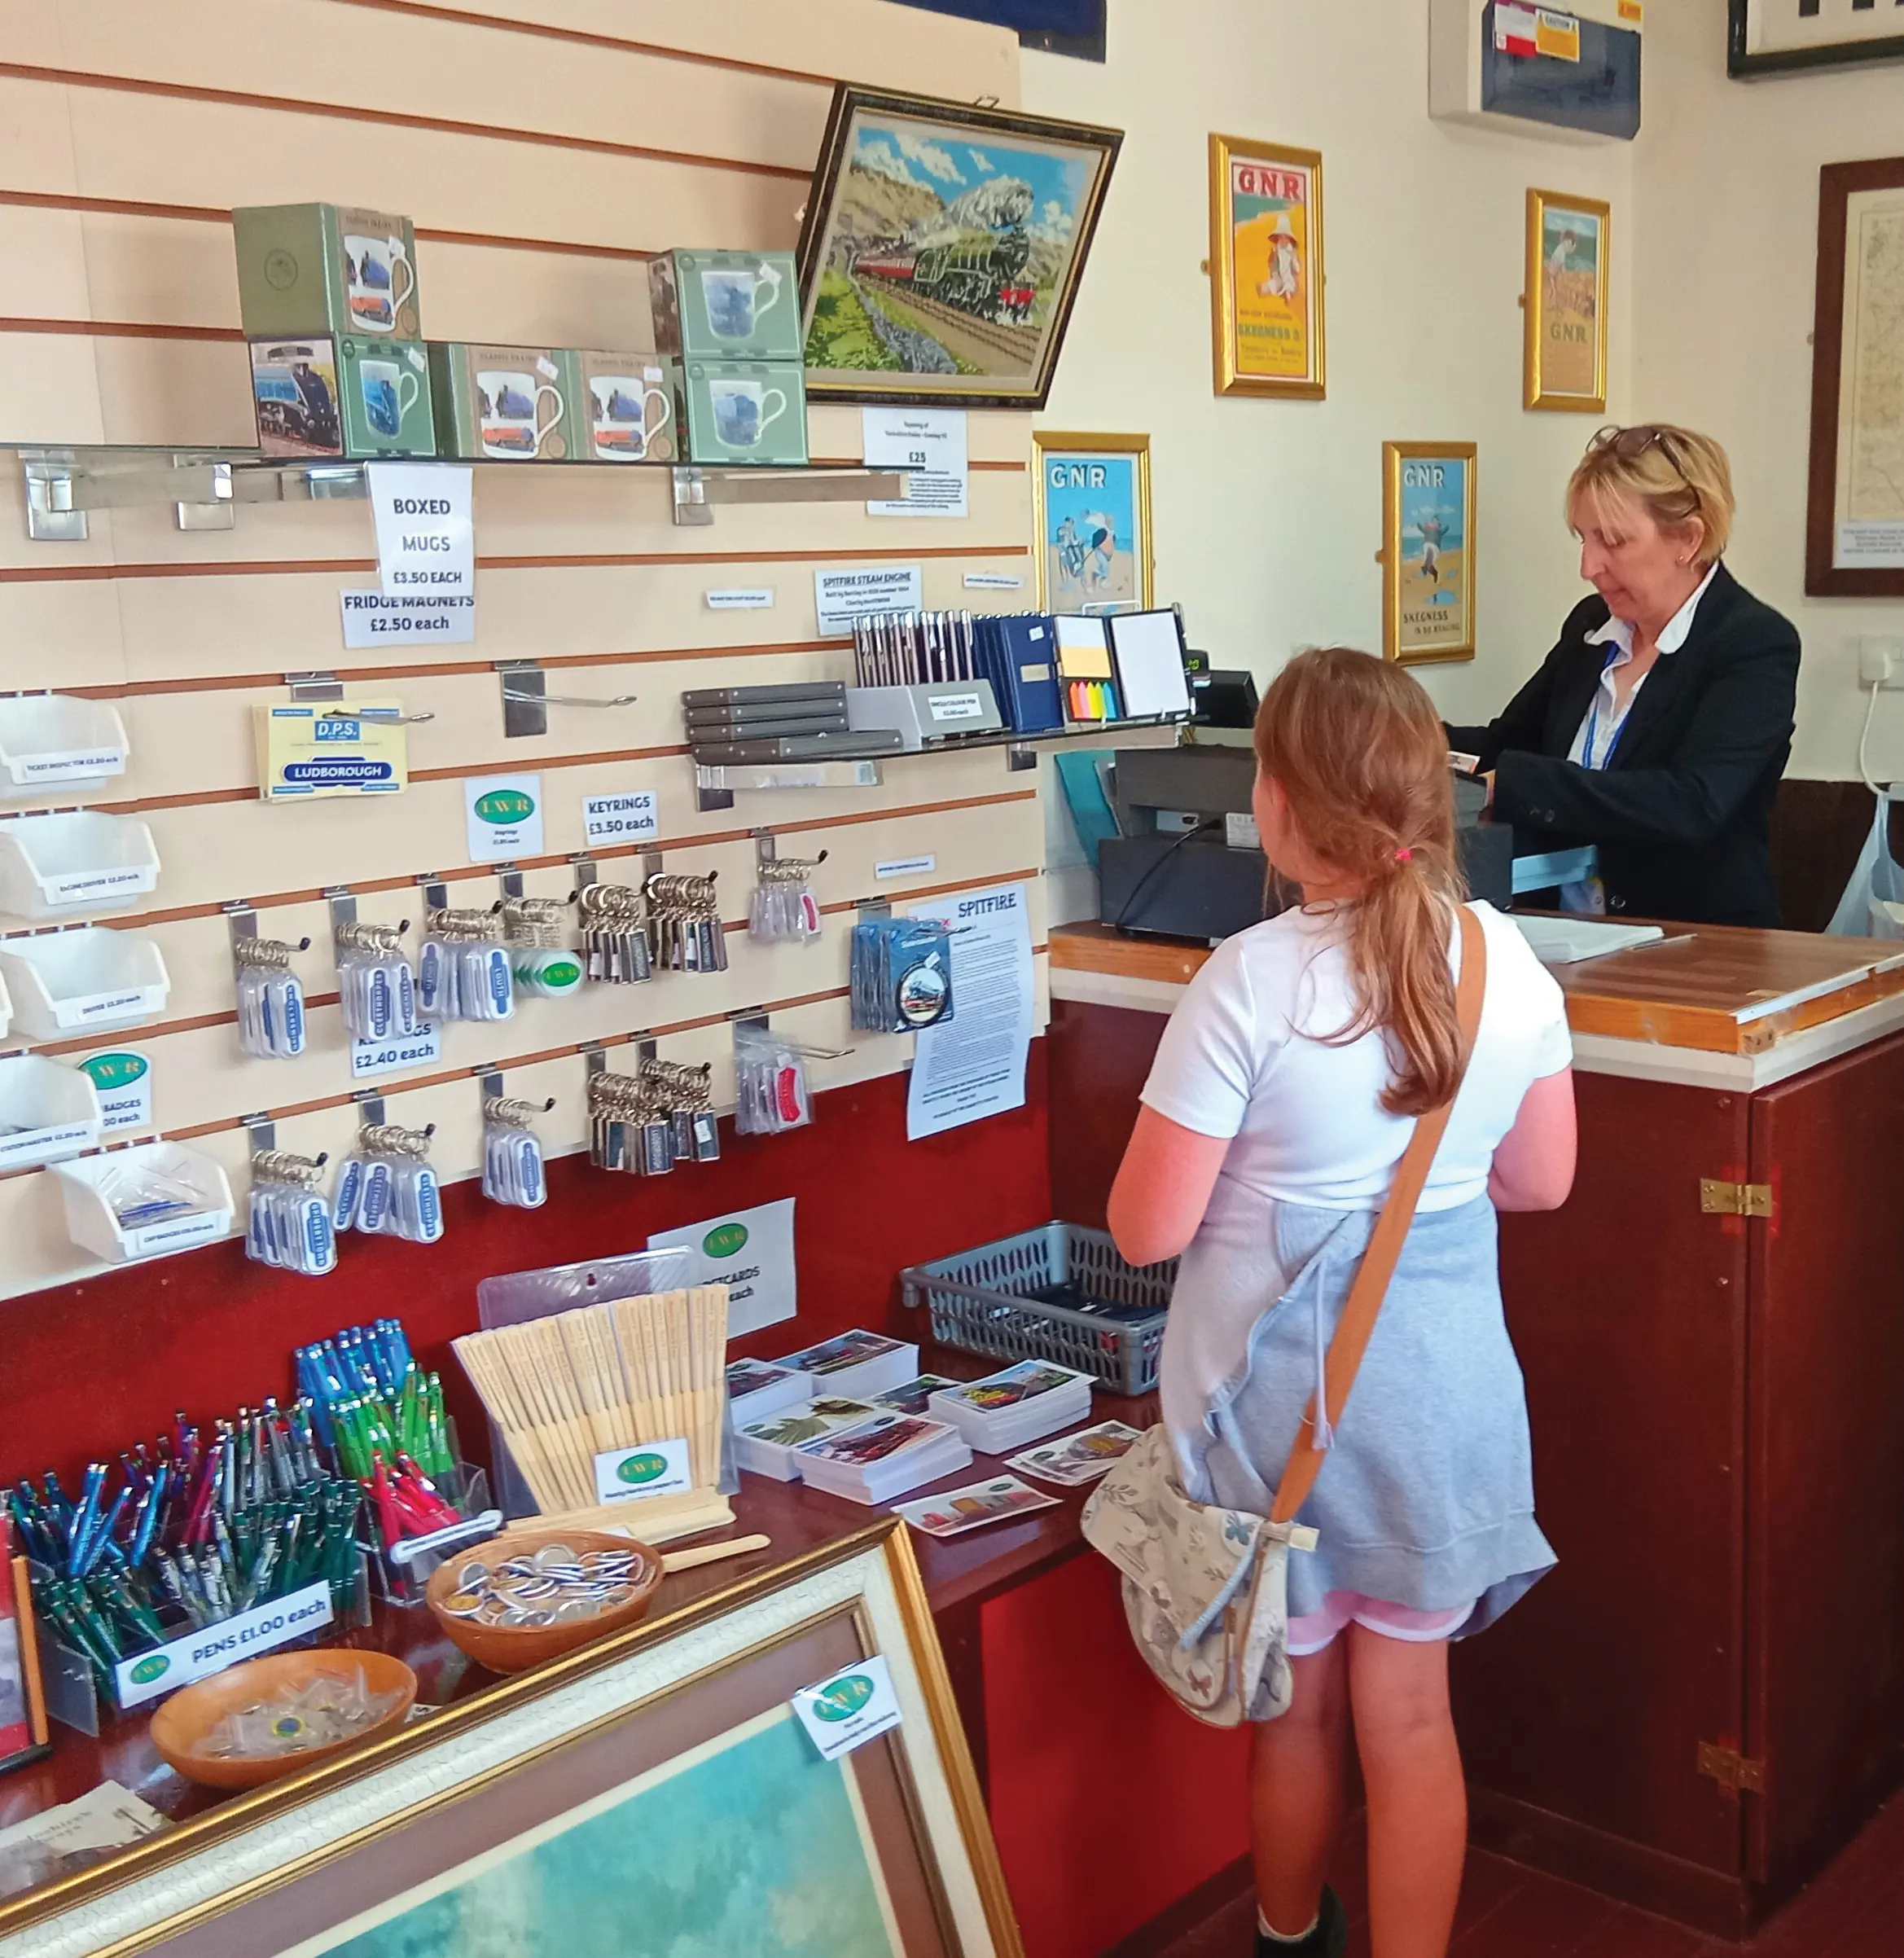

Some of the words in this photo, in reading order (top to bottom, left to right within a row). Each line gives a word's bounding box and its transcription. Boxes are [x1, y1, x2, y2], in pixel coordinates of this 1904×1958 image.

[1239, 166, 1301, 200] GNR
[1550, 321, 1587, 343] GNR
[909, 451, 926, 463] £25
[1050, 463, 1107, 489] GNR
[1403, 464, 1446, 488] GNR
[393, 498, 451, 515] BOXED
[402, 536, 450, 551] MUGS
[393, 572, 428, 584] £3.50
[431, 572, 462, 583] EACH
[823, 575, 857, 588] SPITFIRE
[858, 573, 883, 586] STEAM
[884, 572, 911, 583] ENGINE
[344, 595, 399, 609] FRIDGE
[401, 596, 475, 608] MAGNETS
[371, 617, 412, 632] £2.50
[415, 616, 450, 630] each
[1403, 610, 1448, 624] SKEGNESS
[318, 722, 358, 736] D.P.S.
[294, 766, 383, 778] LUDBOROUGH
[589, 796, 650, 814] KEYRINGS
[589, 820, 622, 836] £3.50
[625, 815, 654, 830] each
[958, 893, 1017, 919] SPITFIRE
[494, 967, 506, 998] LOUTH
[355, 1050, 397, 1069] £2.40
[401, 1043, 434, 1060] each
[103, 1099, 142, 1113] BADGES
[118, 1113, 140, 1124] each
[696, 1266, 761, 1286] TCARDS
[729, 1285, 754, 1302] each
[191, 1635, 237, 1663] PENS
[239, 1615, 285, 1644] £1.00
[288, 1599, 326, 1624] each
